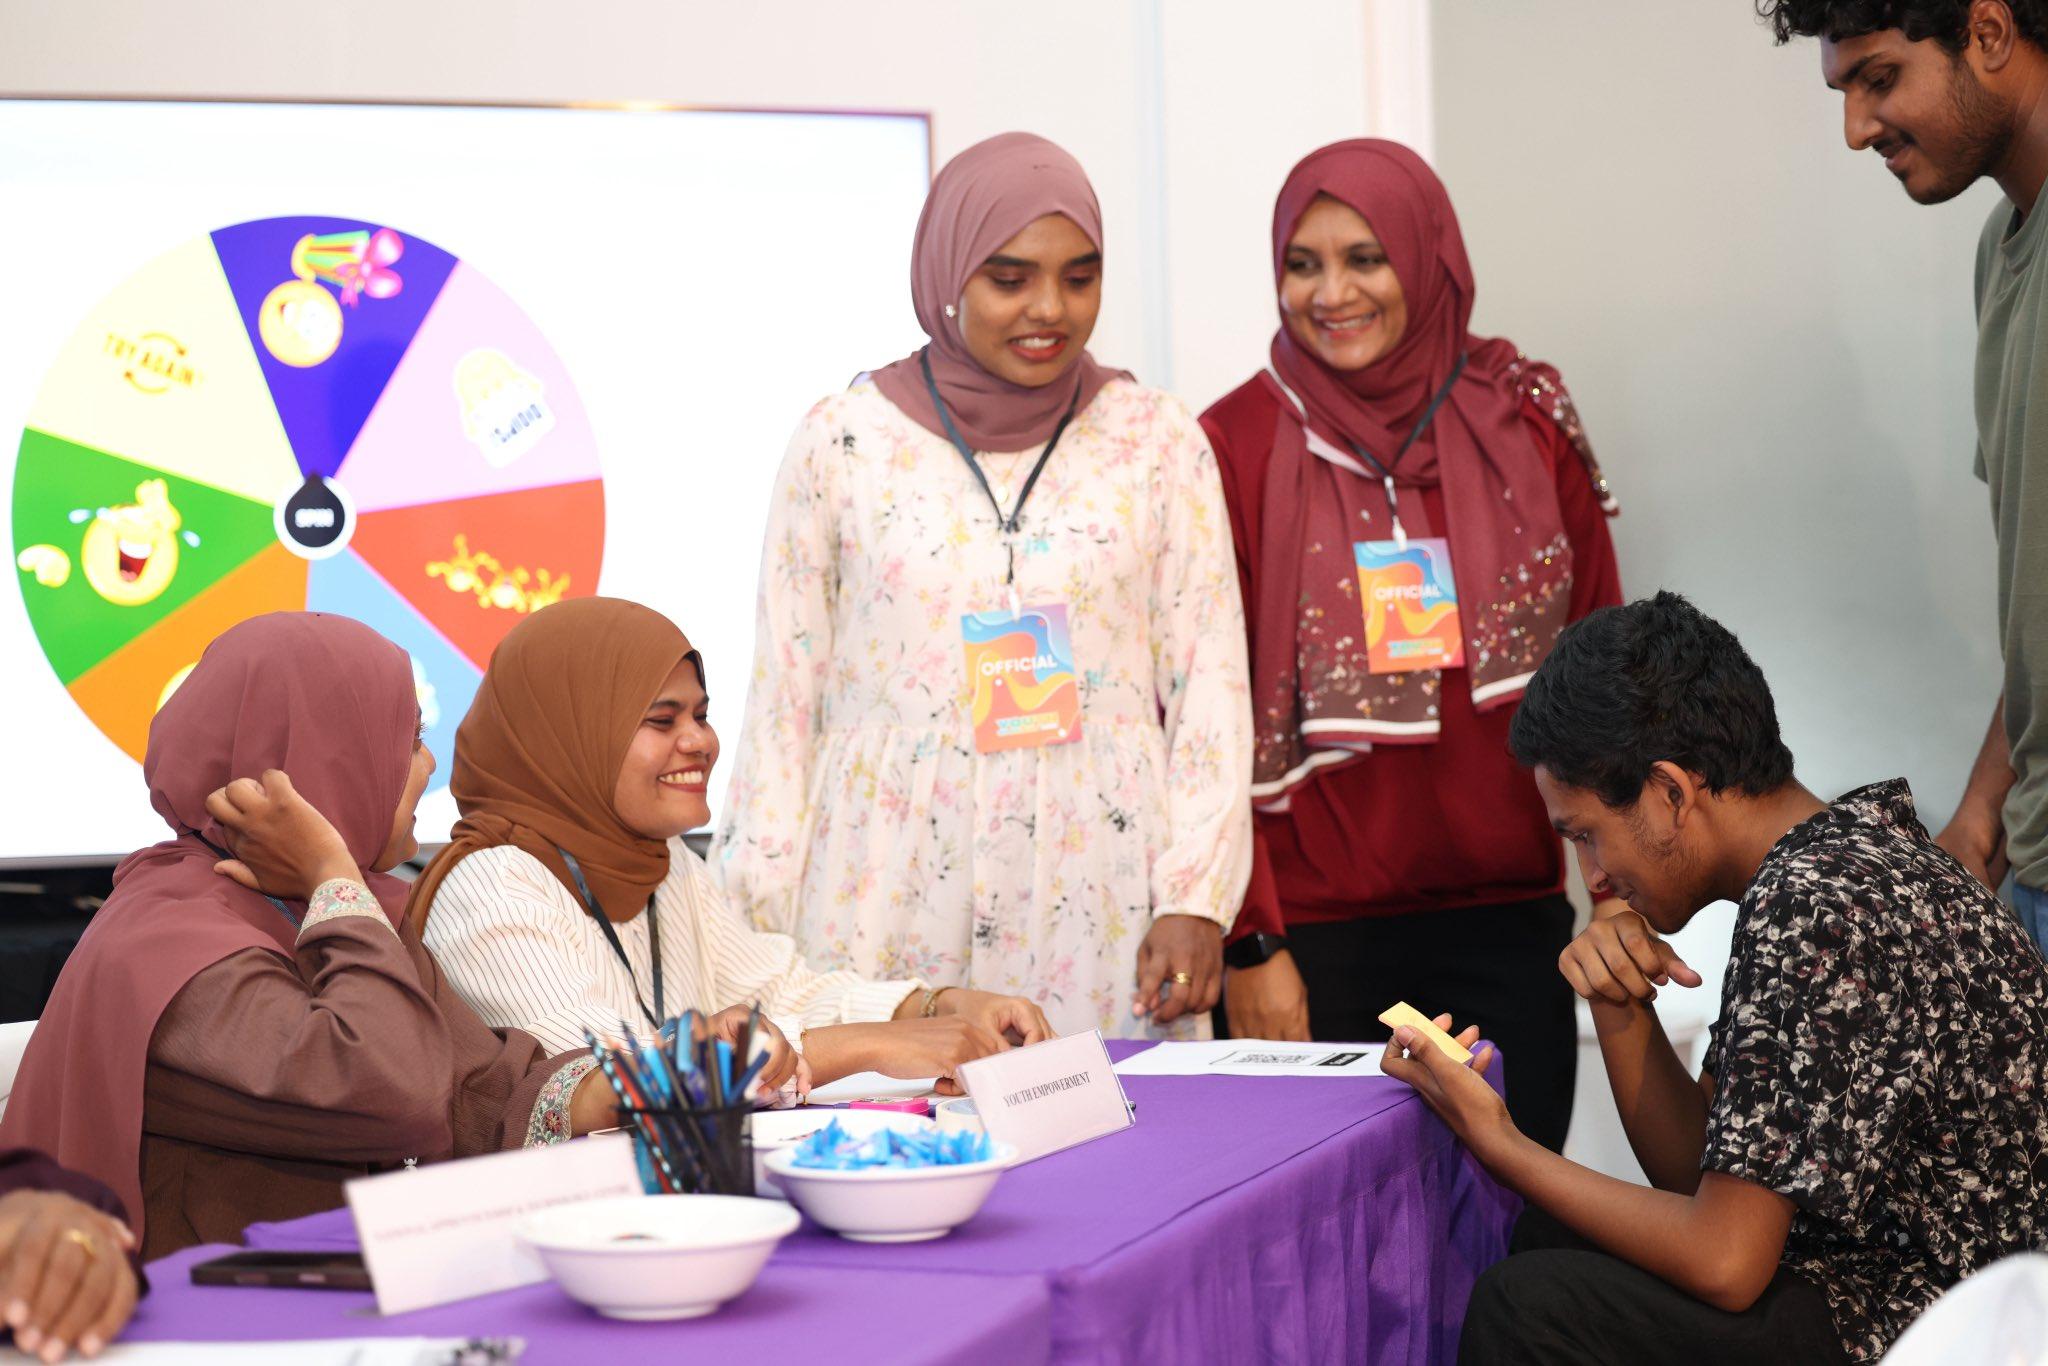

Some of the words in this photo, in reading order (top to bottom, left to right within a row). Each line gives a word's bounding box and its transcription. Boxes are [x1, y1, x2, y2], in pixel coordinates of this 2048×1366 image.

[1376, 584, 1442, 601] OFFICIAL
[981, 655, 1058, 676] OFFICIAL
[1003, 1090, 1032, 1107] YOUTH
[1031, 1071, 1091, 1099] EMPOWERMENT
